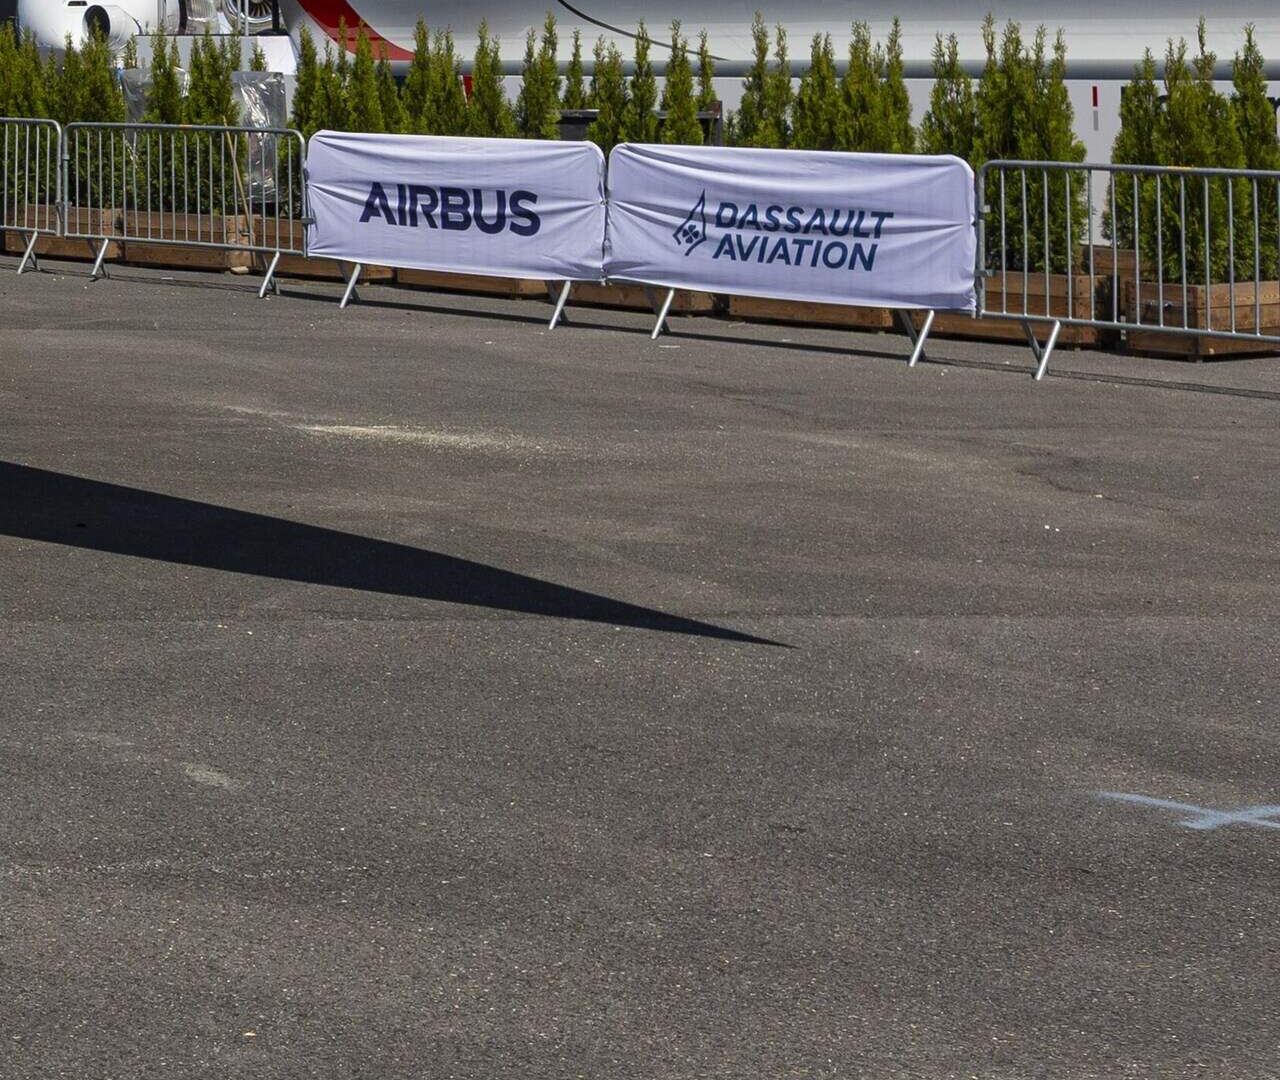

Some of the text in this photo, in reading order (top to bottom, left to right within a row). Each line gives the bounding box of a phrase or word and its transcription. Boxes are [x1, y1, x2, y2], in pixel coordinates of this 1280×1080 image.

[359, 181, 541, 237] AIRBUS
[715, 202, 894, 239] DASSAULT
[712, 233, 878, 272] AVIATION
